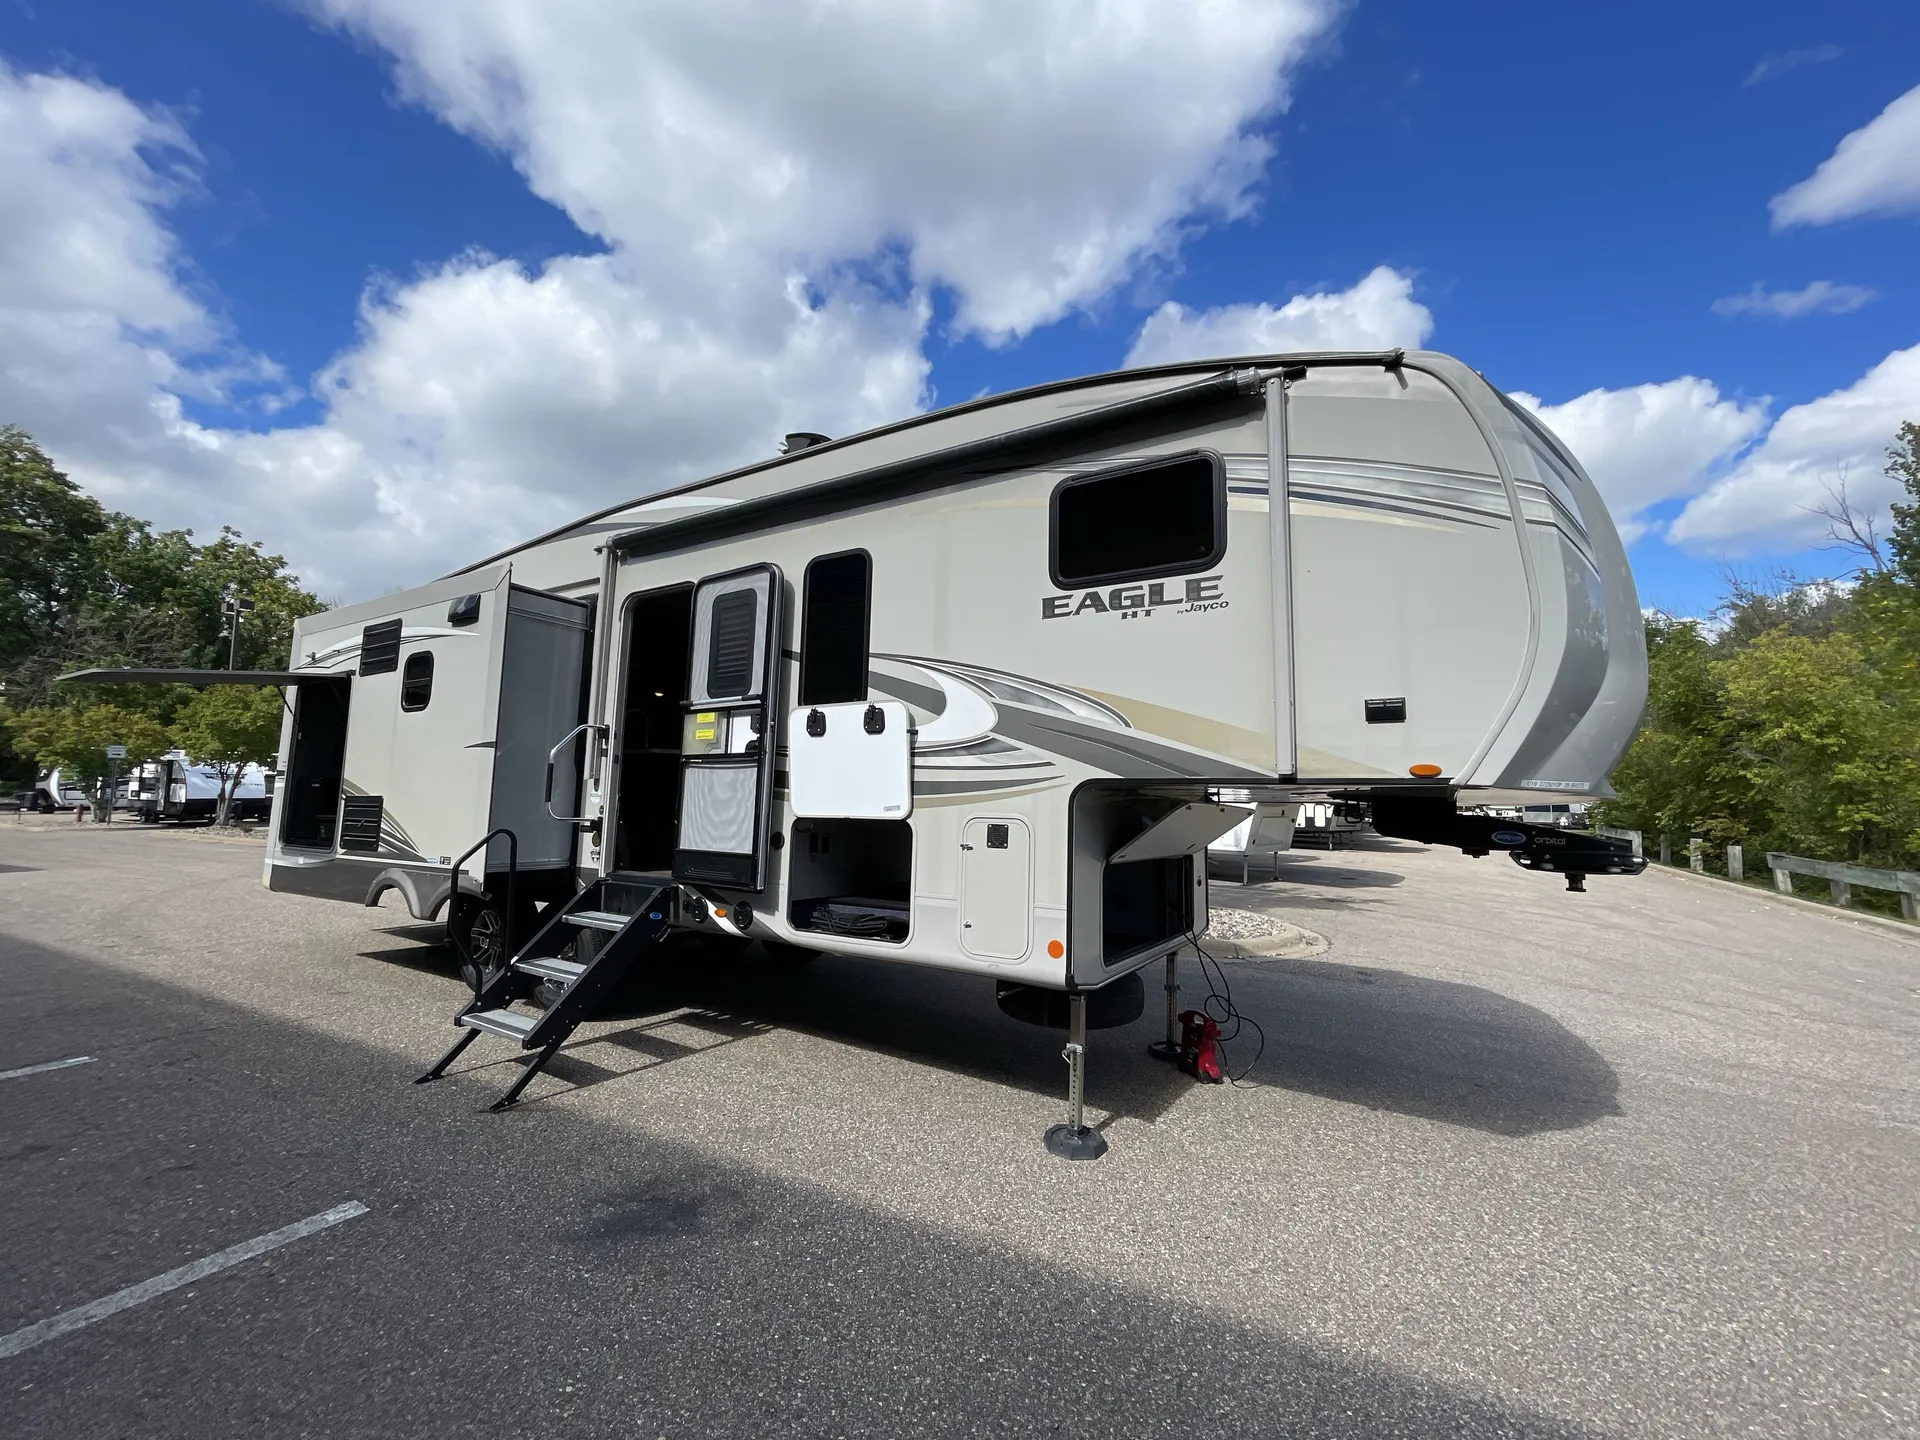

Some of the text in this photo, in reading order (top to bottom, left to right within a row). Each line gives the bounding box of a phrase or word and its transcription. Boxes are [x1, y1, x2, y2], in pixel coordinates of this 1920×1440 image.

[1041, 575, 1224, 620] EAGLE
[1185, 601, 1229, 613] Jayco
[1121, 608, 1156, 620] HT
[1534, 836, 1566, 845] orbital
